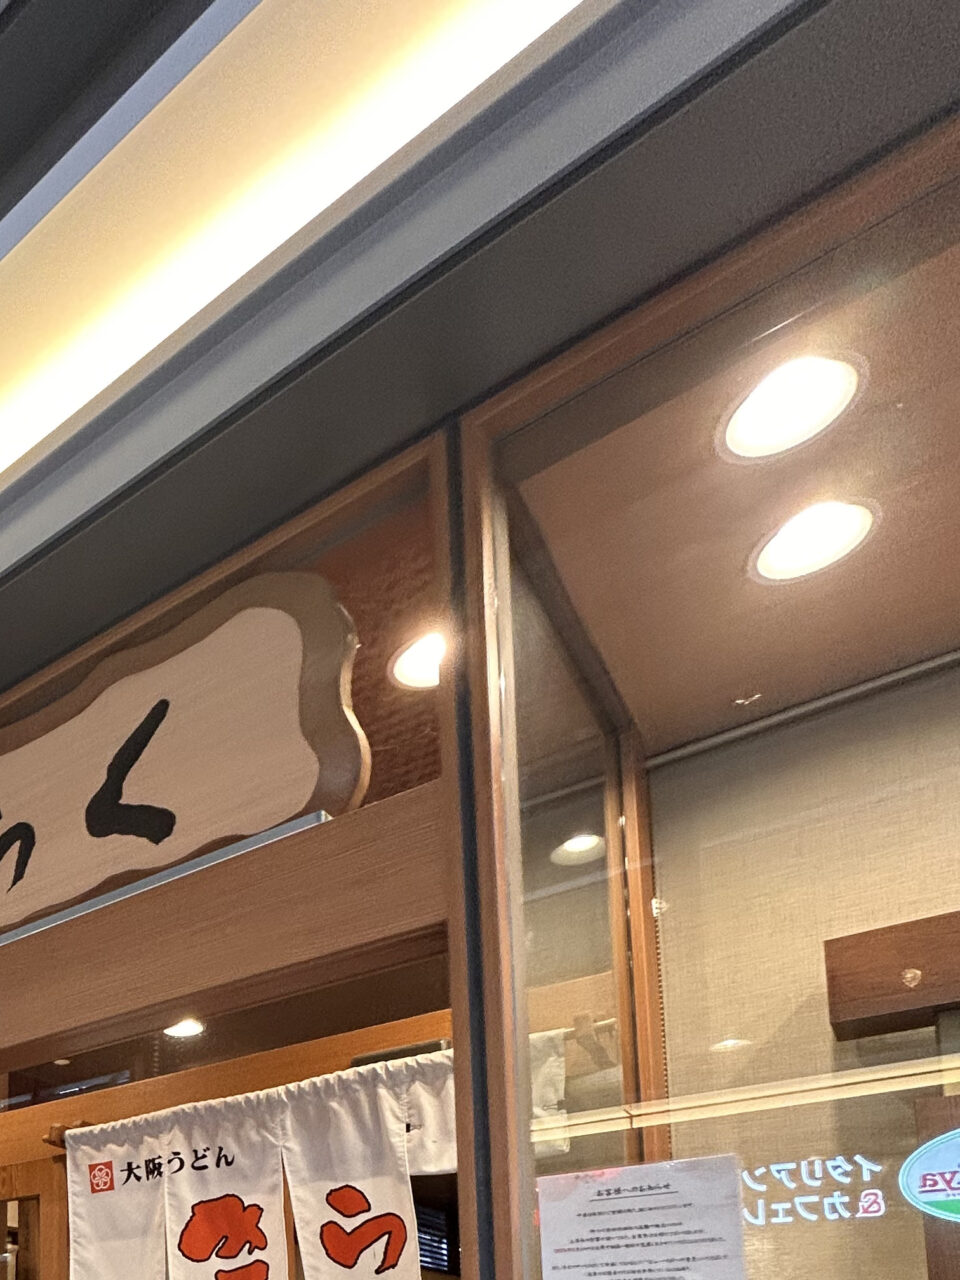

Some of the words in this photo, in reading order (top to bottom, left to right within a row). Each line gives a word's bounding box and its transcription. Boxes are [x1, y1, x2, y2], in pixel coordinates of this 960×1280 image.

[121, 1146, 235, 1186] 大阪うどん
